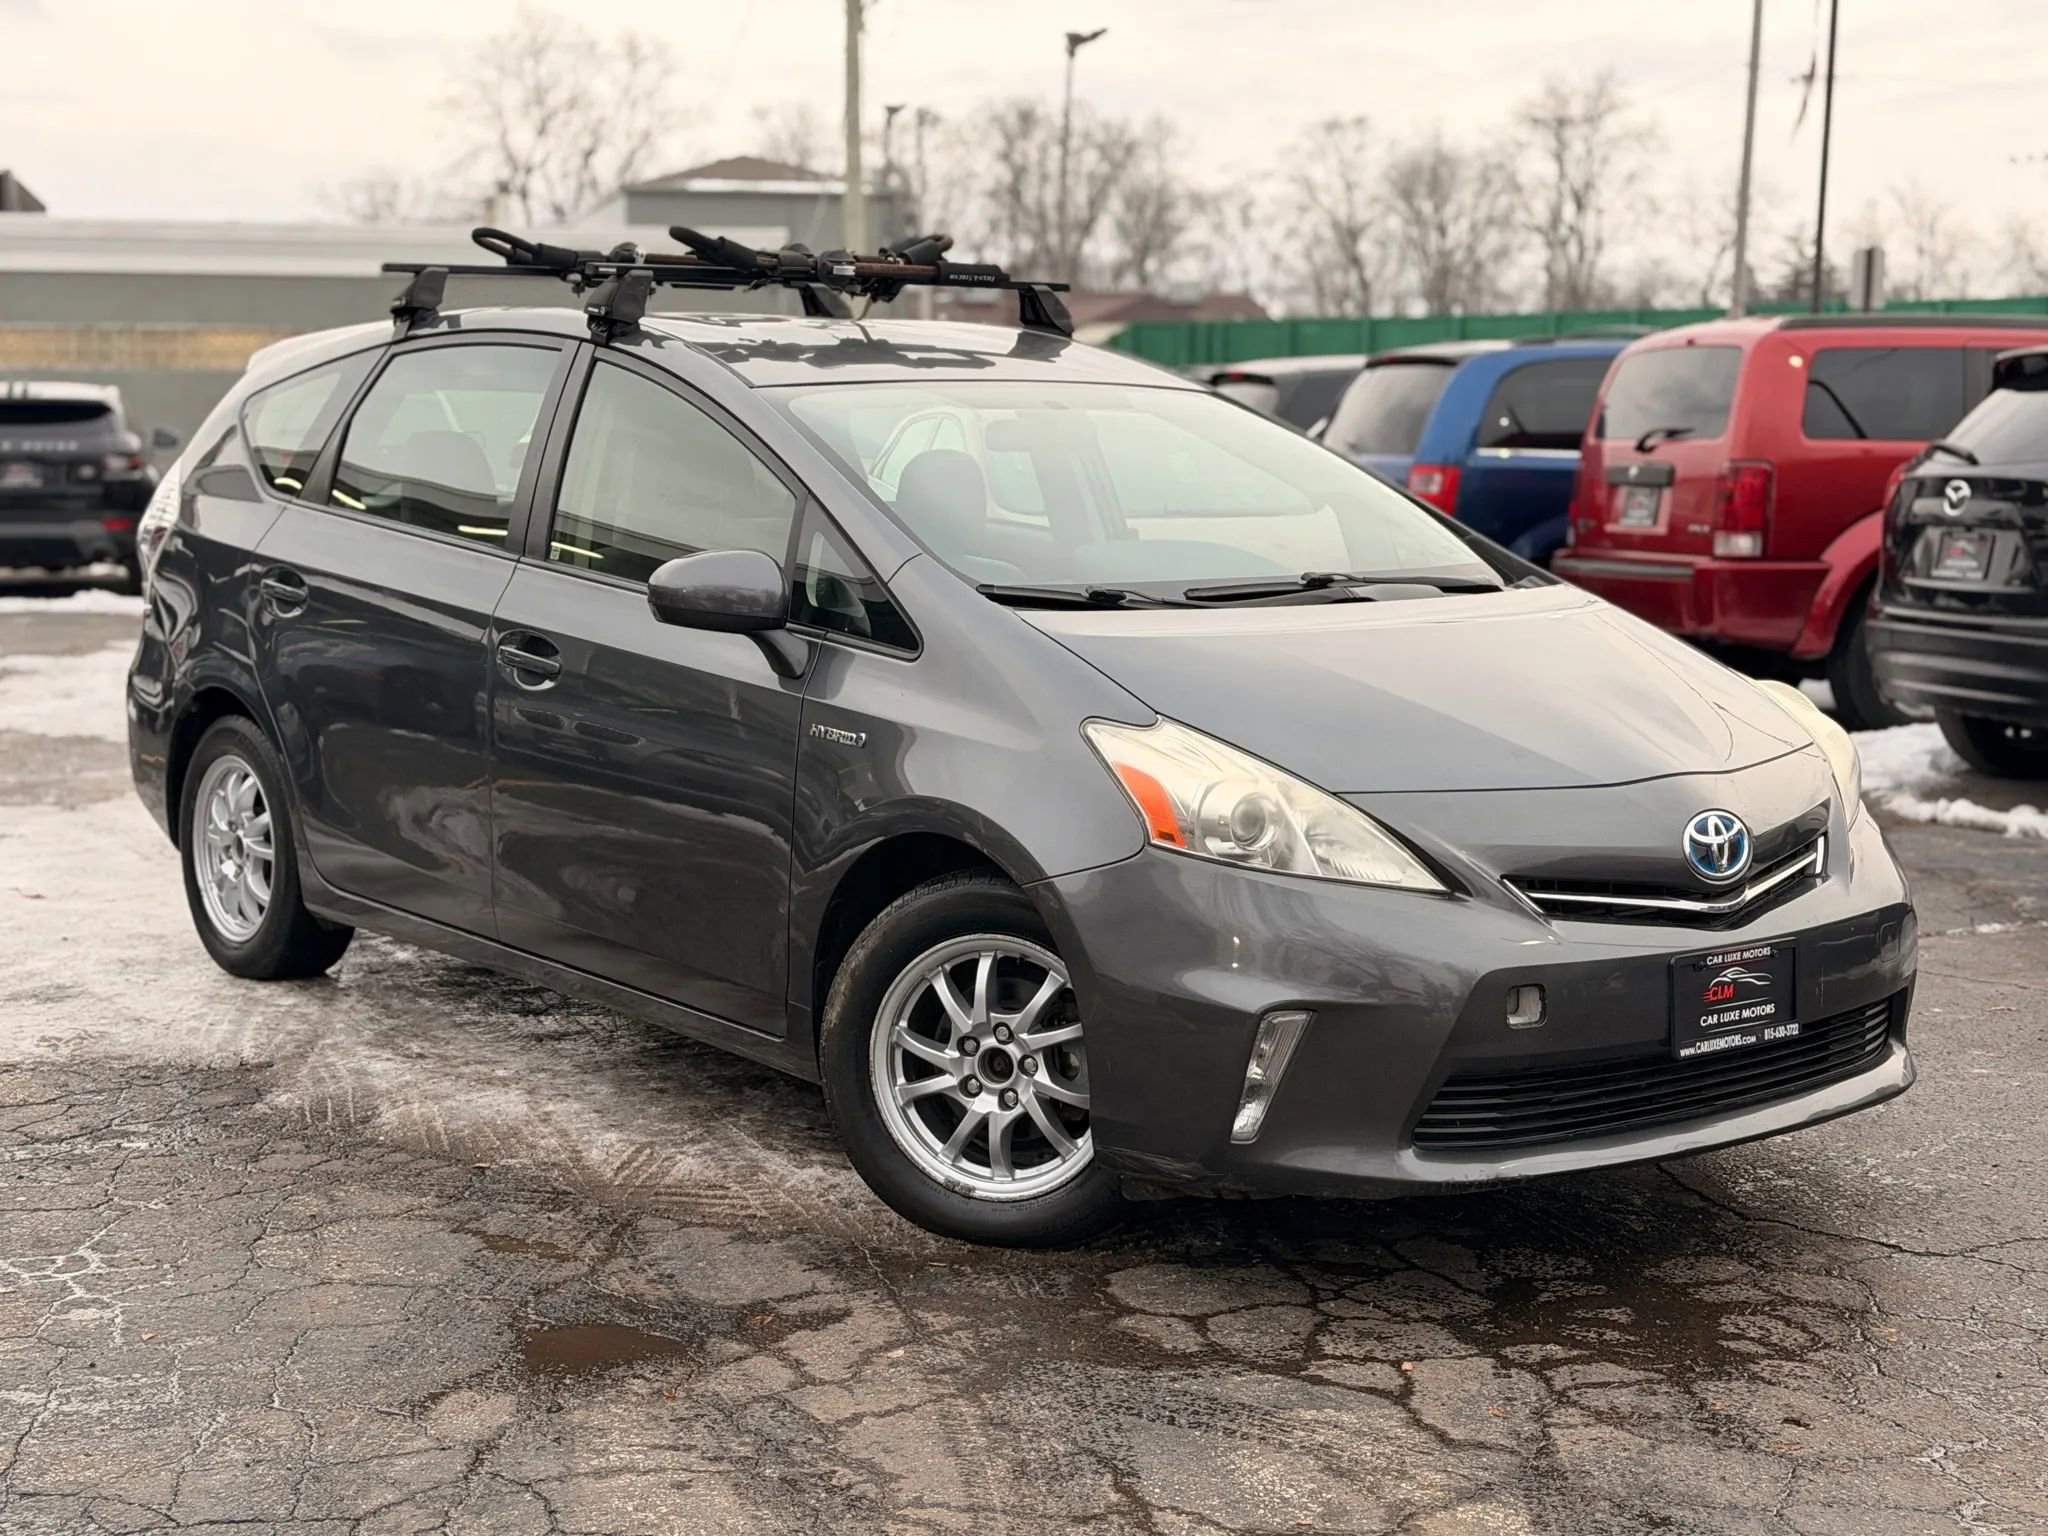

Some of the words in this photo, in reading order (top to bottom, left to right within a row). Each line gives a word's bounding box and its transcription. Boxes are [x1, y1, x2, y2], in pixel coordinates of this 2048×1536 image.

[809, 723, 857, 746] HYBRID
[1706, 954, 1722, 965] CAR
[1724, 951, 1741, 963] LUXE
[1742, 946, 1771, 960] MOTORS
[1709, 984, 1734, 1000] CLM
[1700, 1014, 1718, 1026] CAR
[1720, 1009, 1740, 1023] LUXE
[1741, 1003, 1775, 1019] MOTORS
